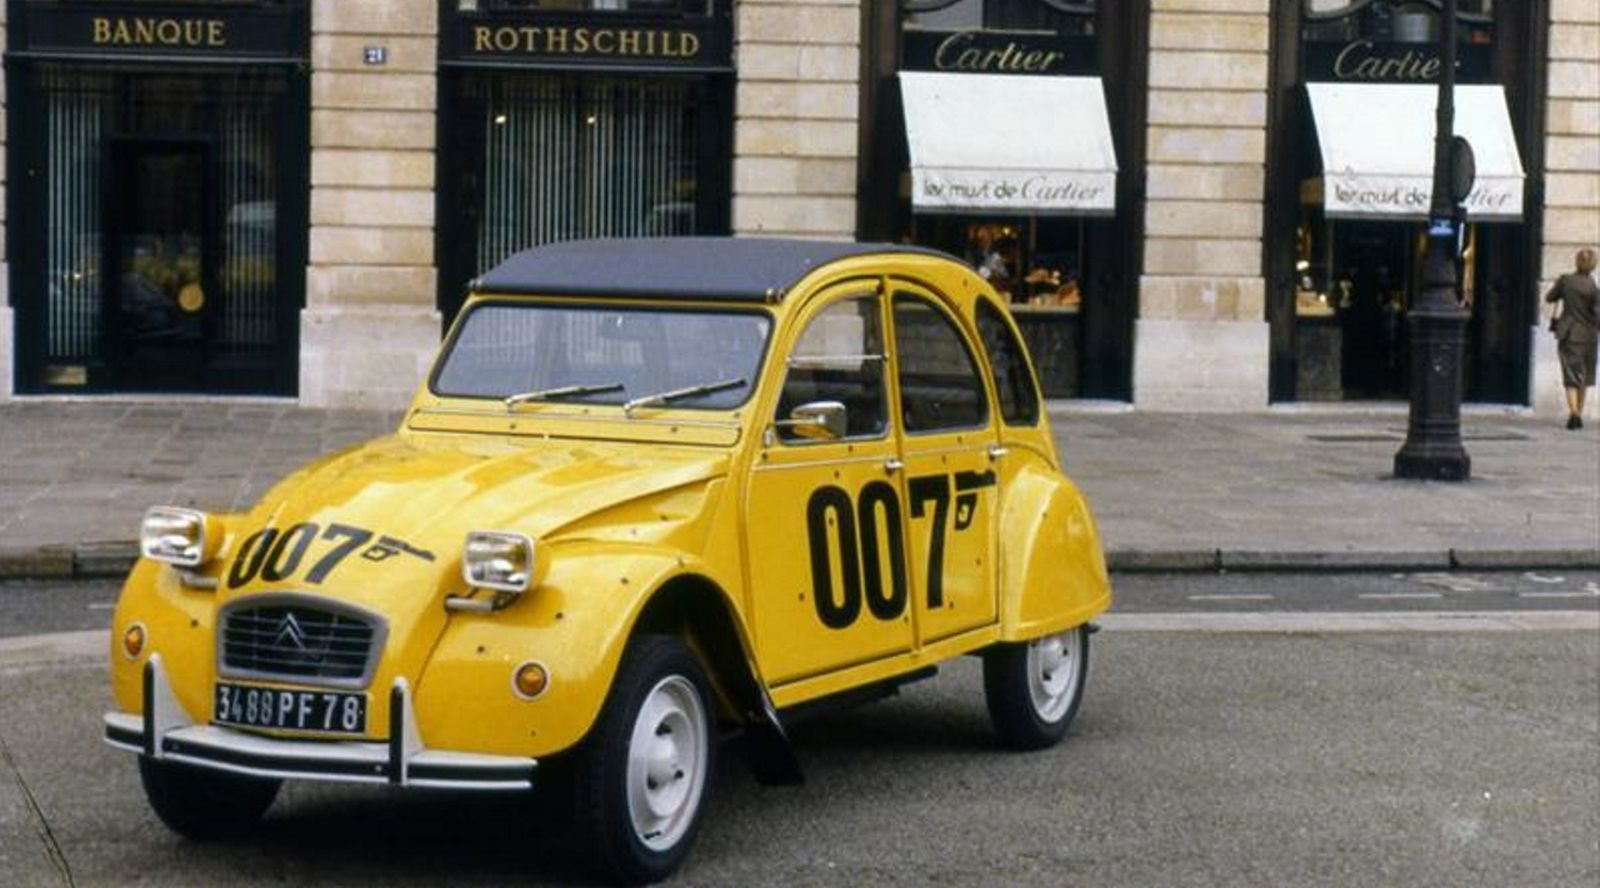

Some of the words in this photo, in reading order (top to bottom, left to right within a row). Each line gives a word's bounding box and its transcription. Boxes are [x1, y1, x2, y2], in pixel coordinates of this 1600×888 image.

[93, 18, 226, 46] BANQUE
[474, 26, 700, 57] ROTHSCHILD
[934, 30, 1064, 71] Cartier
[1333, 40, 1461, 79] Cartie
[993, 180, 1018, 199] de
[1021, 175, 1104, 200] Cartier
[1405, 186, 1428, 205] de
[227, 522, 375, 590] 007
[807, 473, 950, 630] 007
